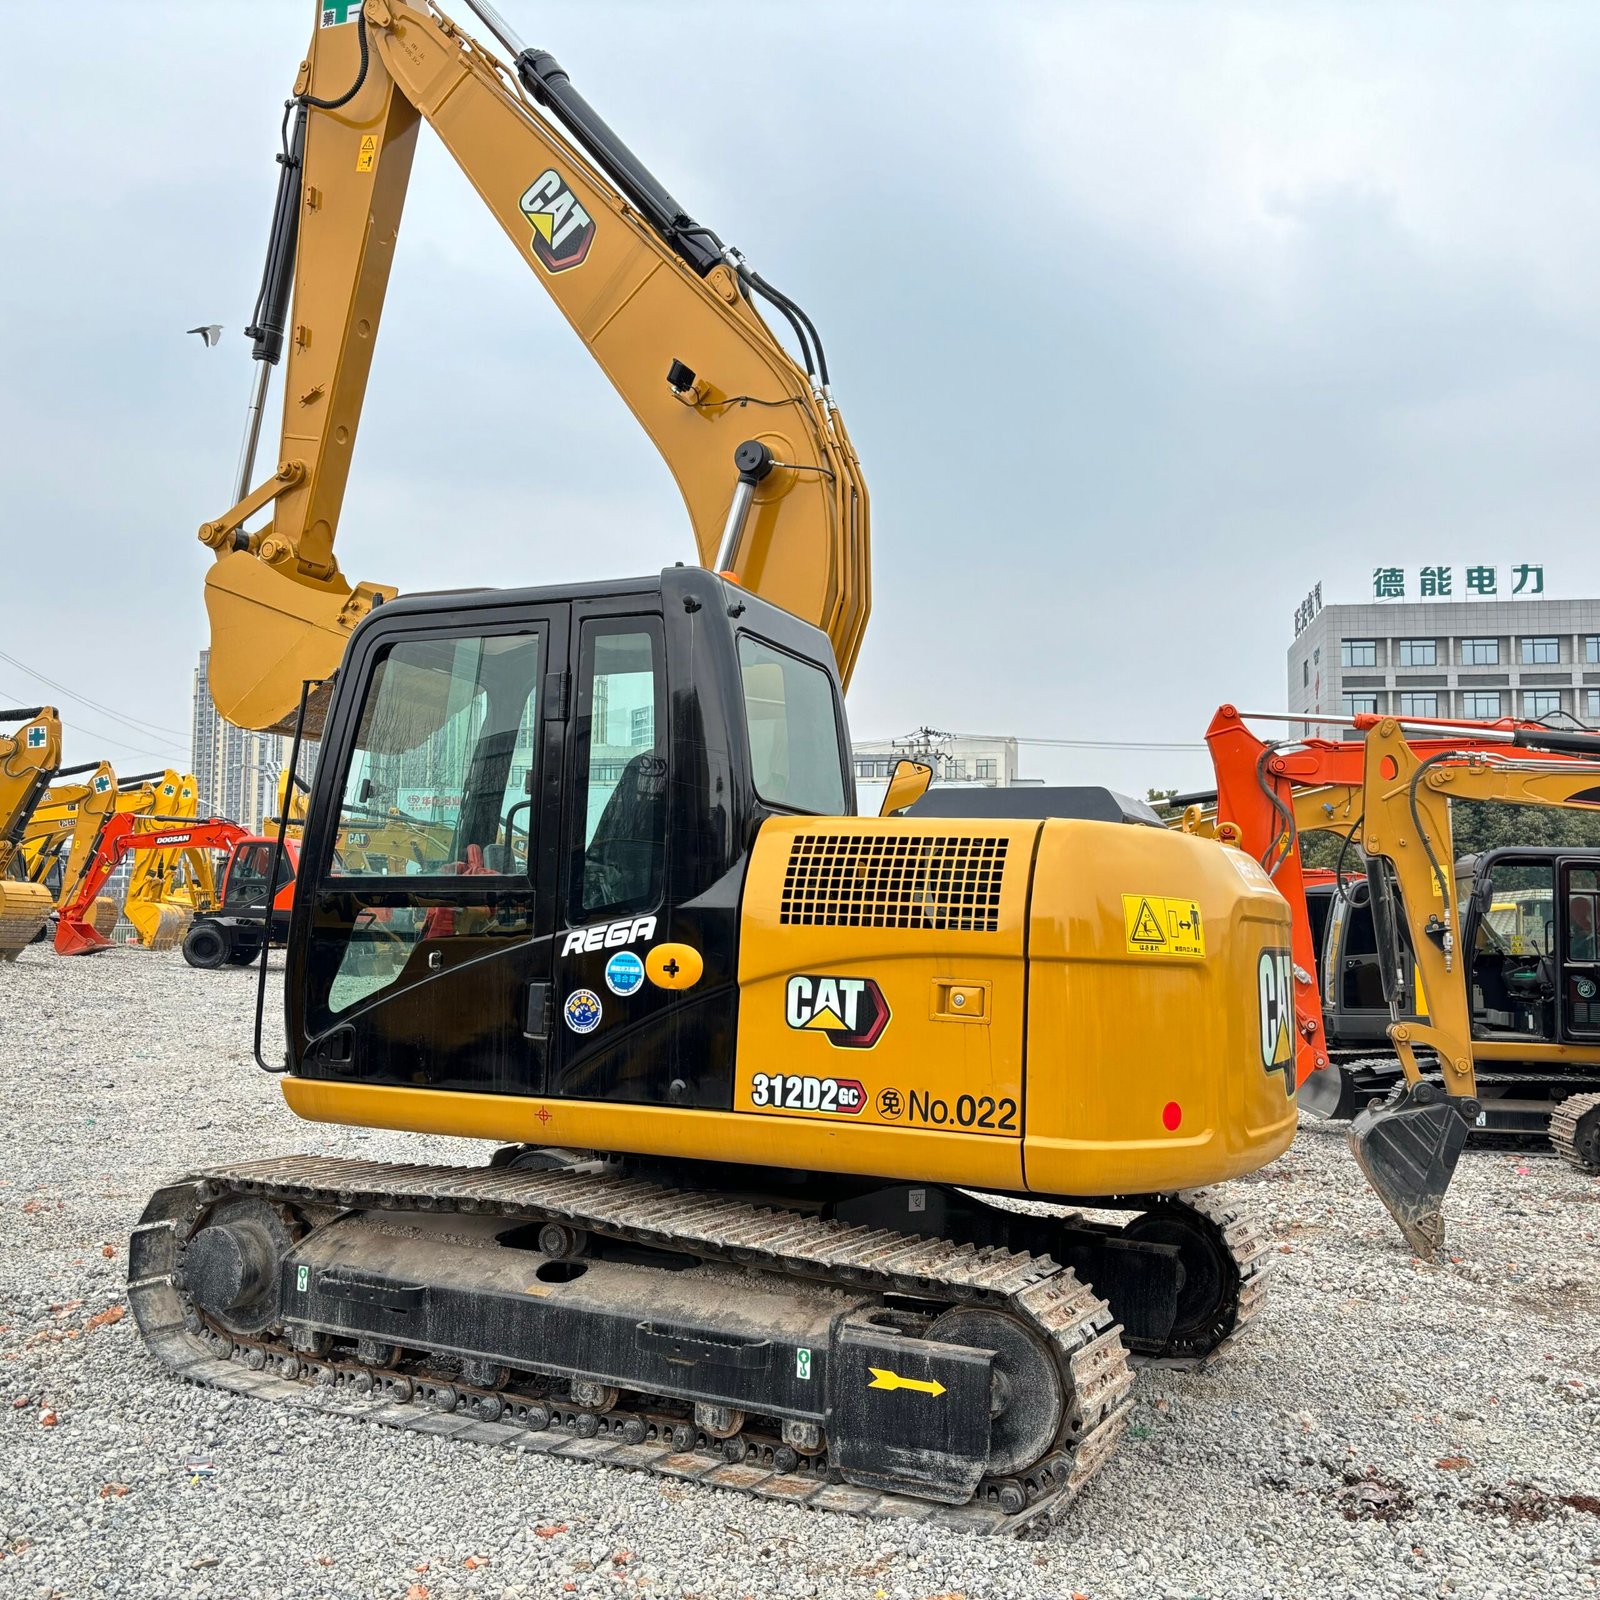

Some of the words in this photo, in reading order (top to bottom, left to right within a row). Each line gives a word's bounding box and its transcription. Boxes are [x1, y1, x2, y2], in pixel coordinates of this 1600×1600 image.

[520, 170, 591, 250] CAT
[1373, 564, 1544, 598] 德能电力
[156, 834, 190, 844] DOOSAN
[348, 833, 366, 845] CAT
[561, 916, 657, 957] REGA
[787, 976, 865, 1031] CAT
[1260, 953, 1294, 1067] CAT
[752, 1074, 837, 1111] 312D2
[838, 1086, 859, 1106] GC
[909, 1090, 1017, 1131] No.022
